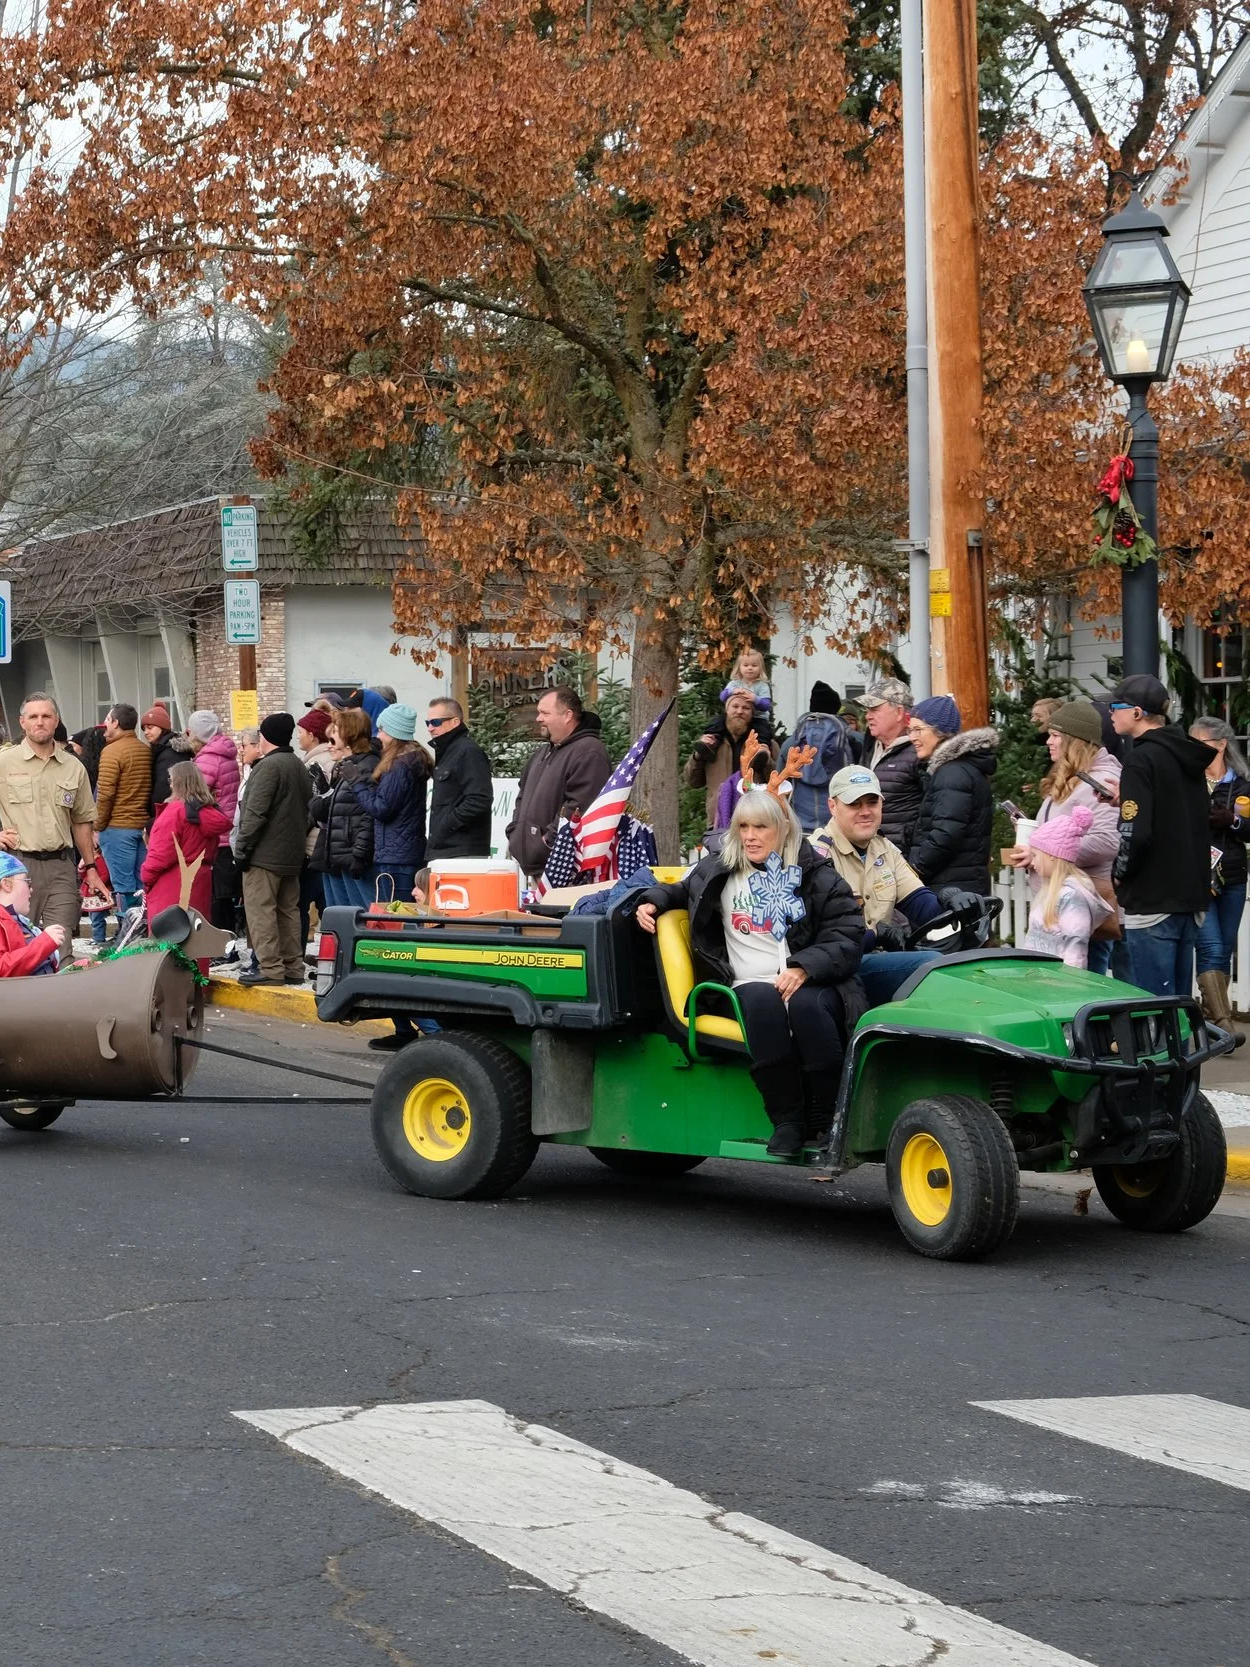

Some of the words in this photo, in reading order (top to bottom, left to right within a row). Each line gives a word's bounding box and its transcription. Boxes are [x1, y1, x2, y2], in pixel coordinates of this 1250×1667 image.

[223, 511, 232, 525] NO
[232, 512, 254, 521] PARKING
[227, 528, 252, 537] VEHICLES
[226, 539, 239, 548] OVER
[233, 549, 247, 558] HIGH
[235, 587, 248, 596] TWO
[233, 599, 251, 607] HOUR
[230, 610, 255, 619] PARKING
[382, 949, 414, 961] GATOR
[493, 953, 525, 966] JOHN
[527, 955, 565, 967] DEERE
